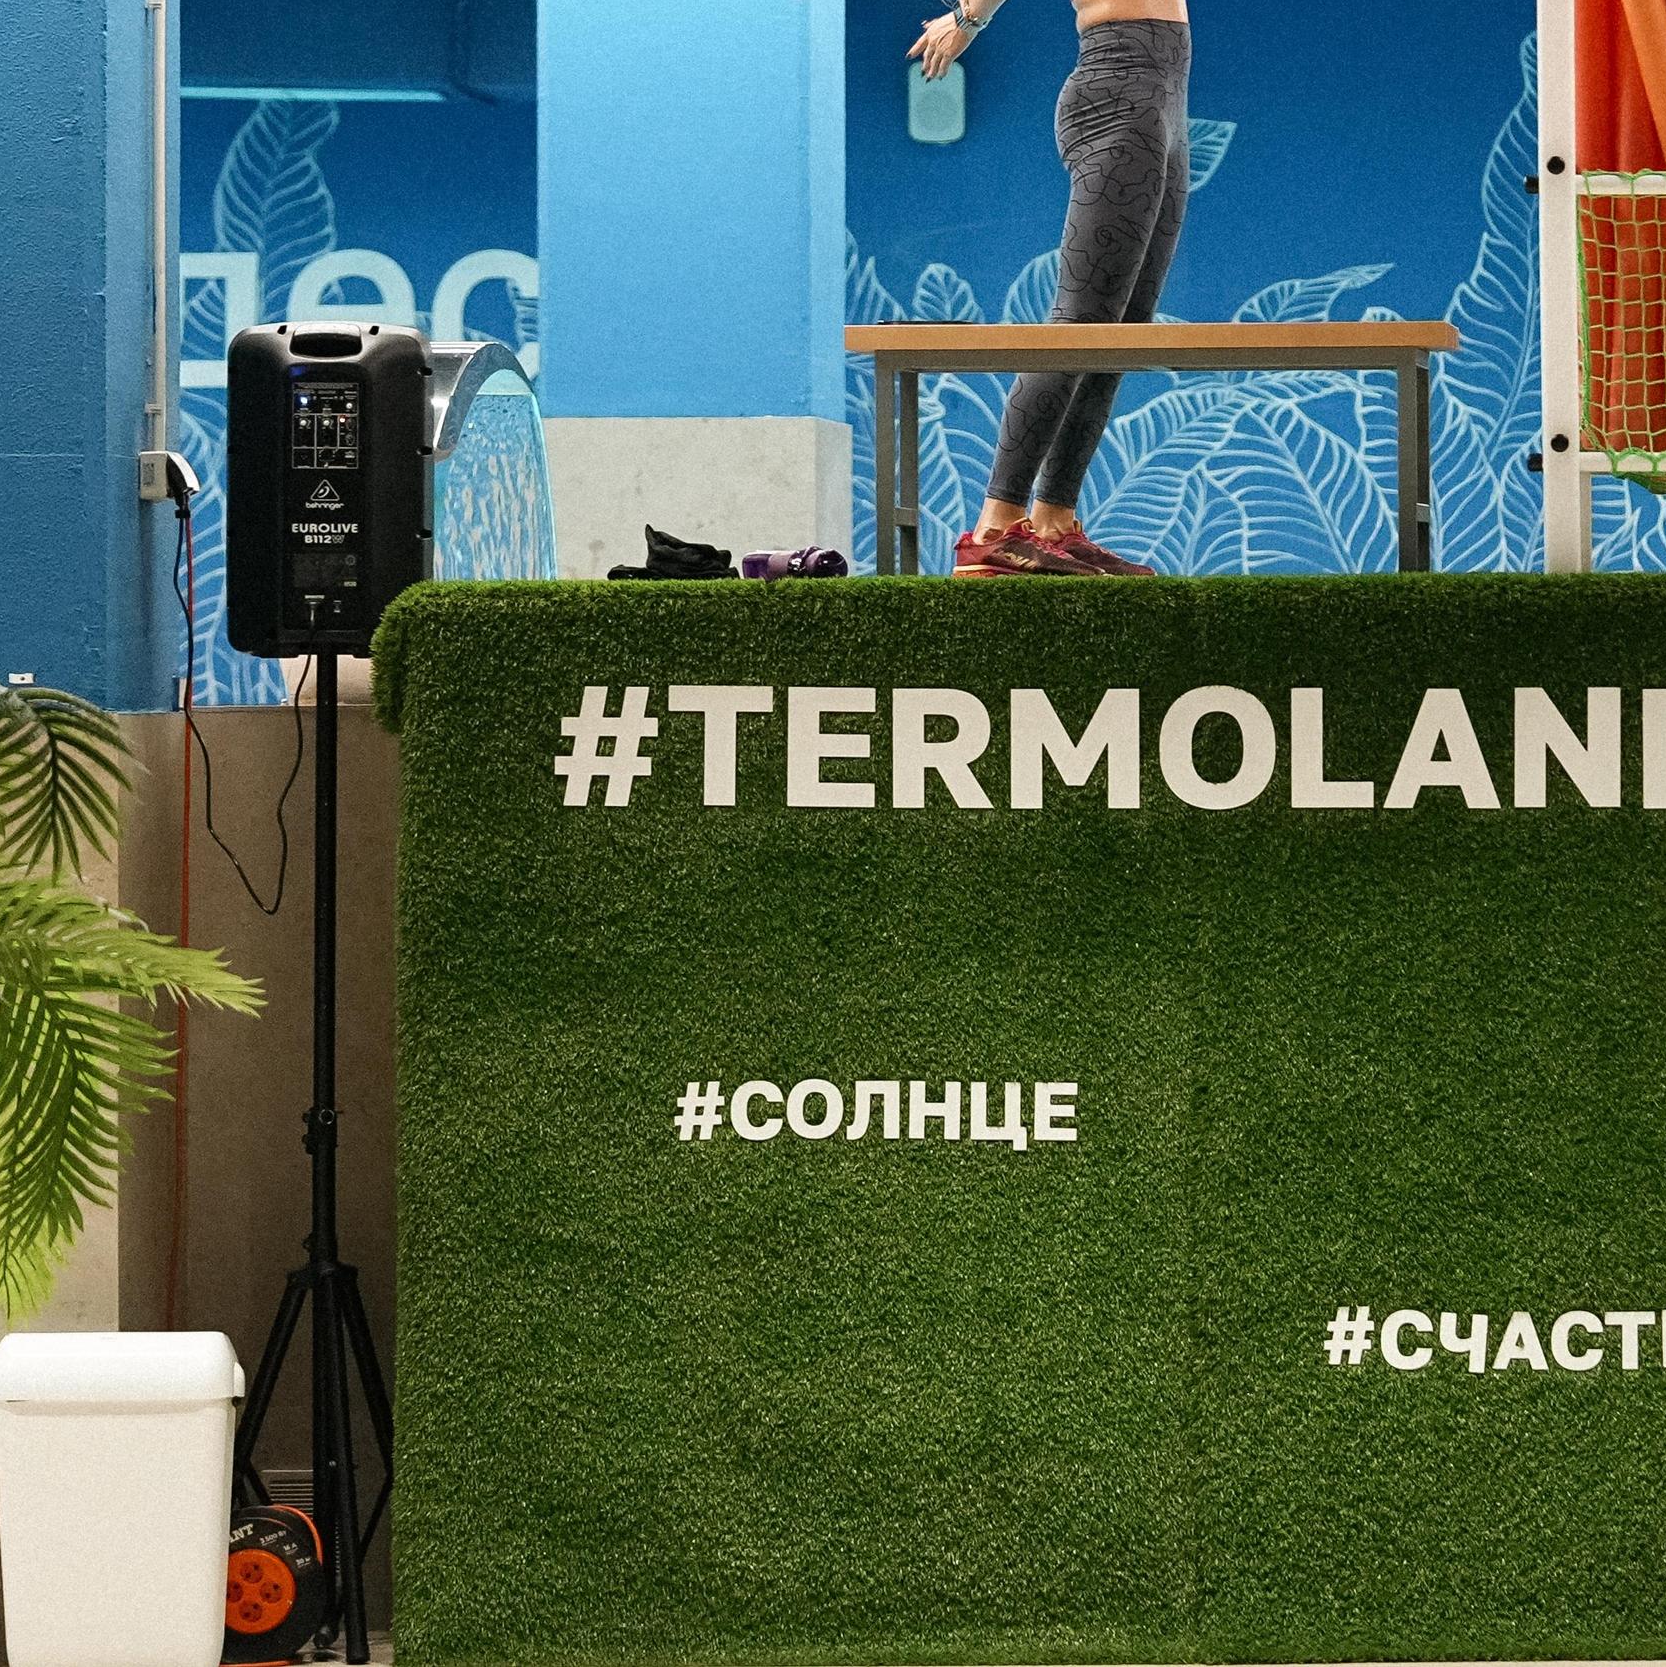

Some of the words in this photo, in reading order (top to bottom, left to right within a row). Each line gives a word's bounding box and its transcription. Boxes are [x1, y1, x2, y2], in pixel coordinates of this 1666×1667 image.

[305, 502, 344, 510] behringer
[292, 523, 358, 533] EUROLIVE
[673, 1078, 1079, 1151] #СОЛНЦЕ
